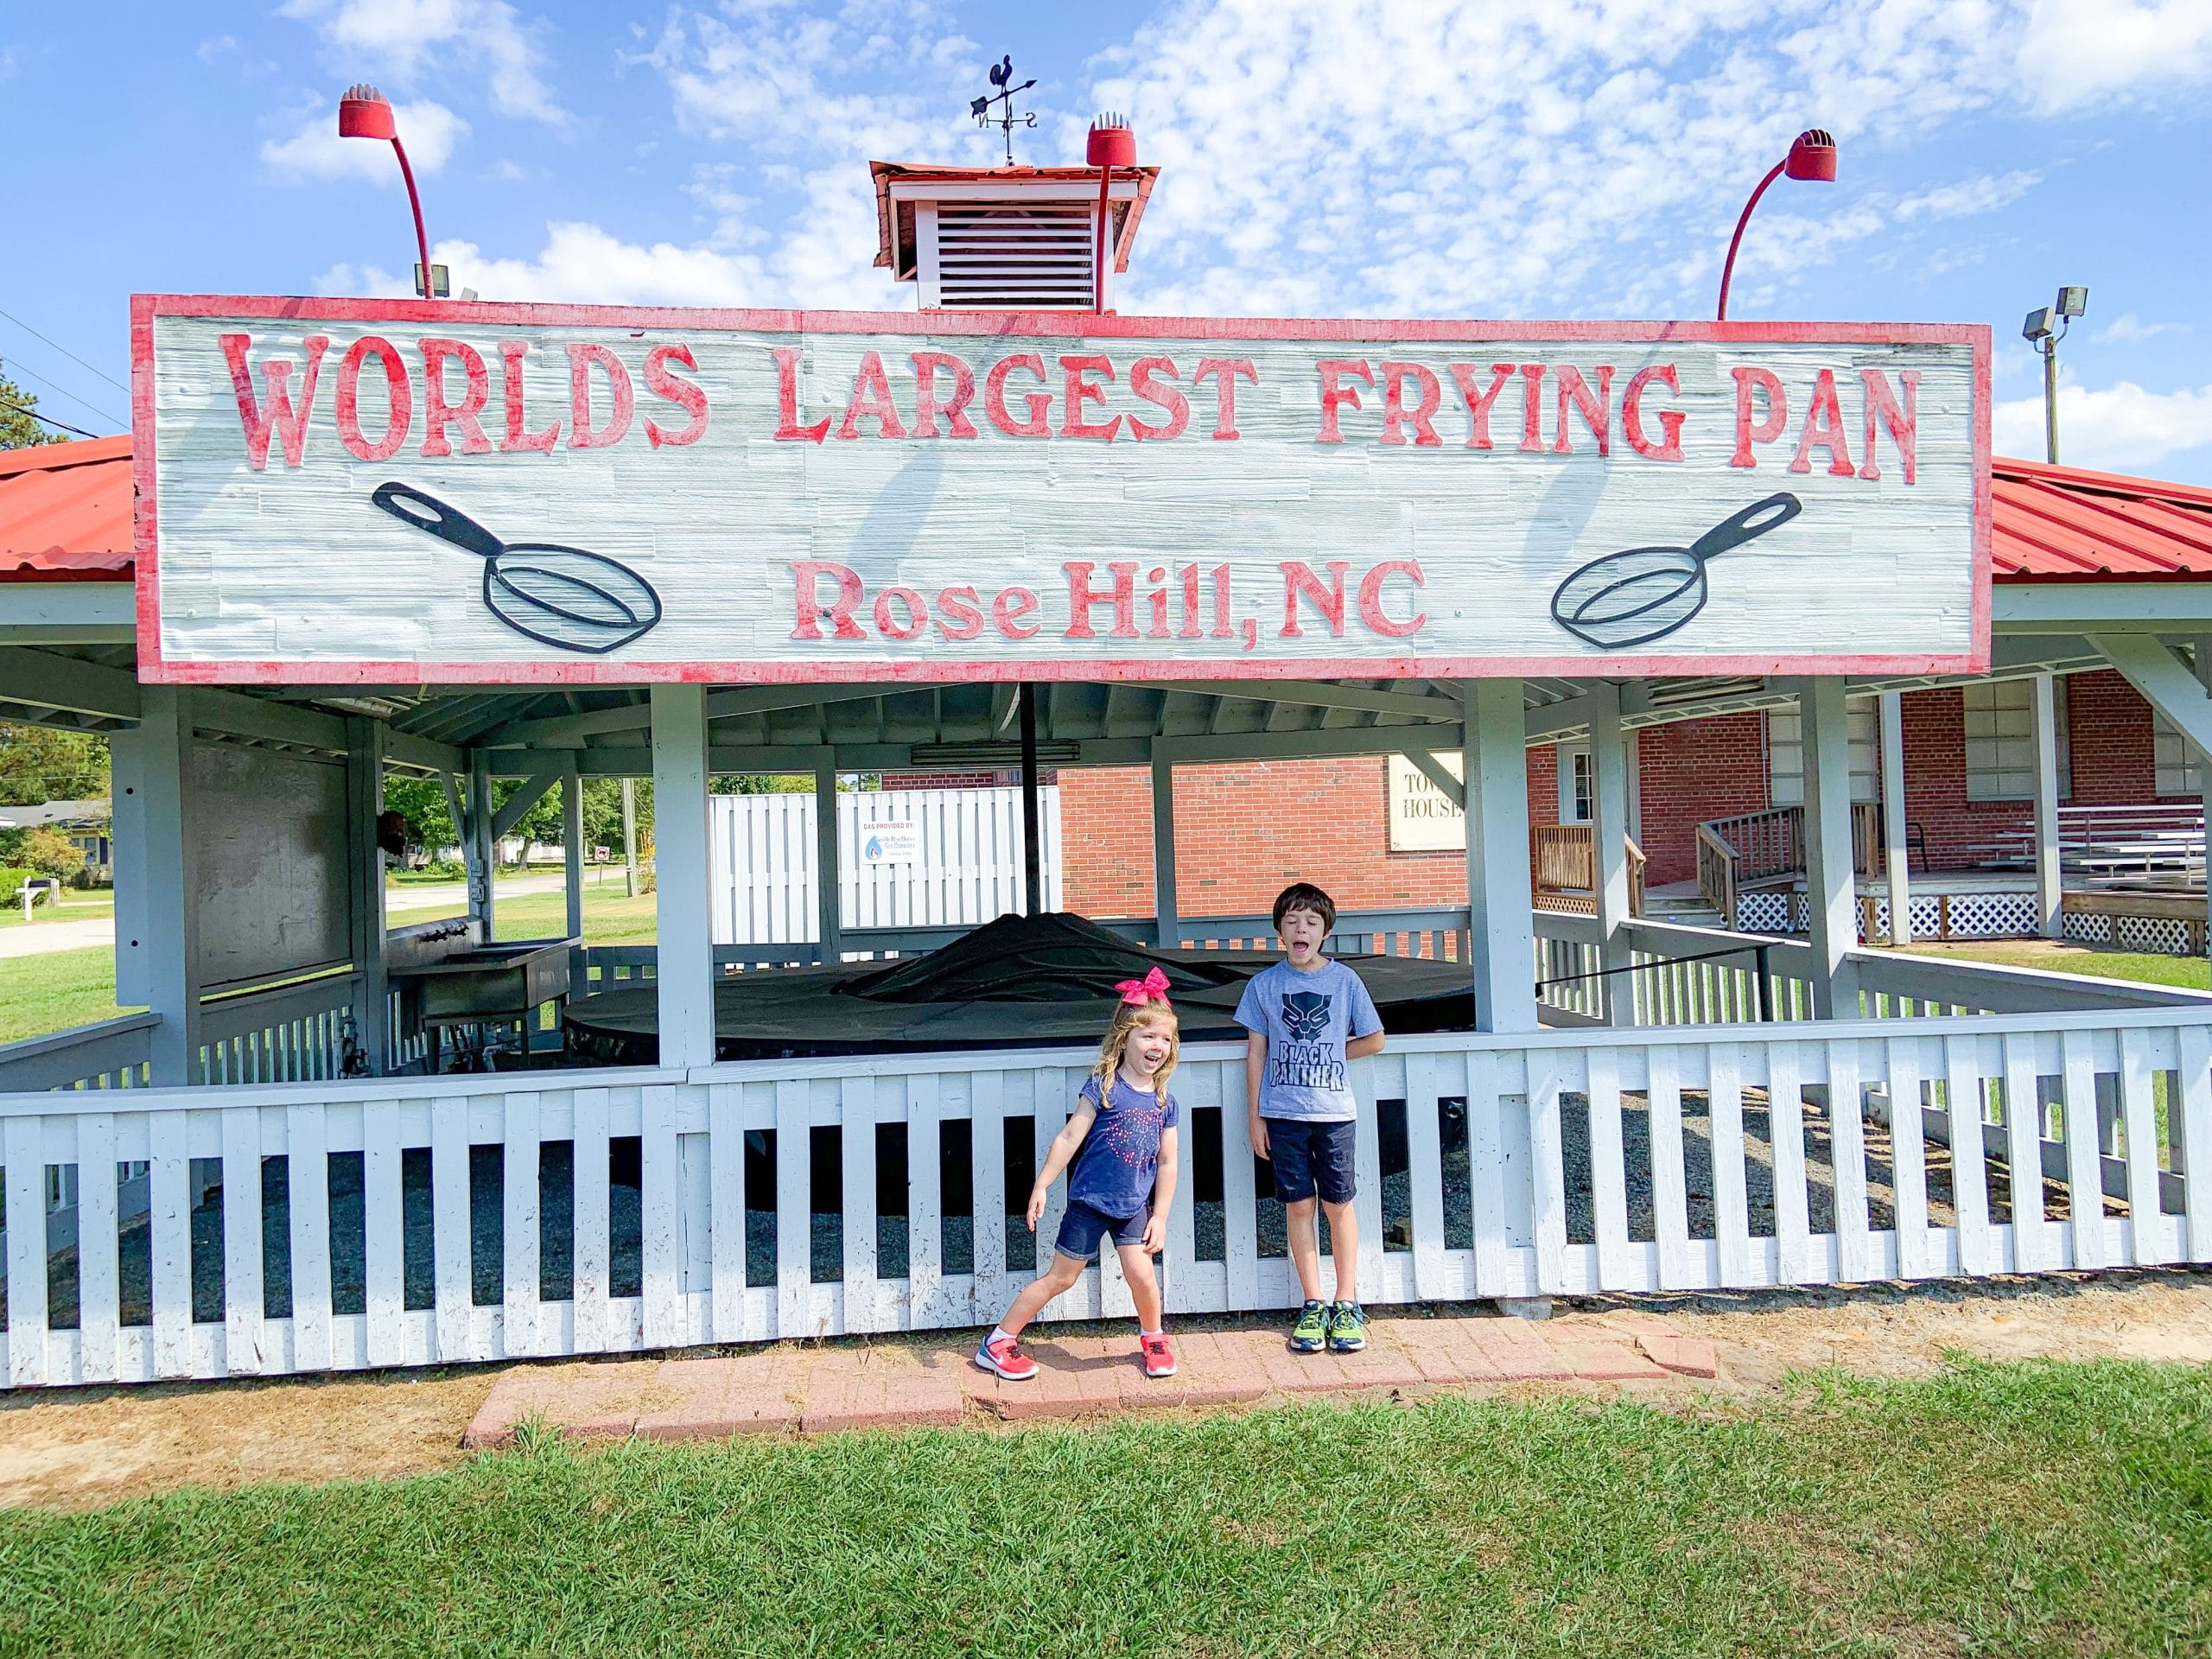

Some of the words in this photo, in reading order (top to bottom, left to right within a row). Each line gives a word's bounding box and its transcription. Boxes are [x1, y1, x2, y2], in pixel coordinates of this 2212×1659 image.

[219, 334, 709, 470] WORLDS
[772, 348, 1259, 443] LARGEST
[1316, 359, 1686, 461] FRYING
[1730, 366, 1922, 485] PAN
[791, 561, 1040, 641] Rose
[1064, 562, 1258, 651] Hill,
[1279, 559, 1427, 638] NC
[1405, 773, 1457, 793] TO
[1404, 798, 1462, 818] HOUSE
[1279, 1040, 1334, 1065] BLACK
[1271, 1058, 1344, 1091] PANTHER
